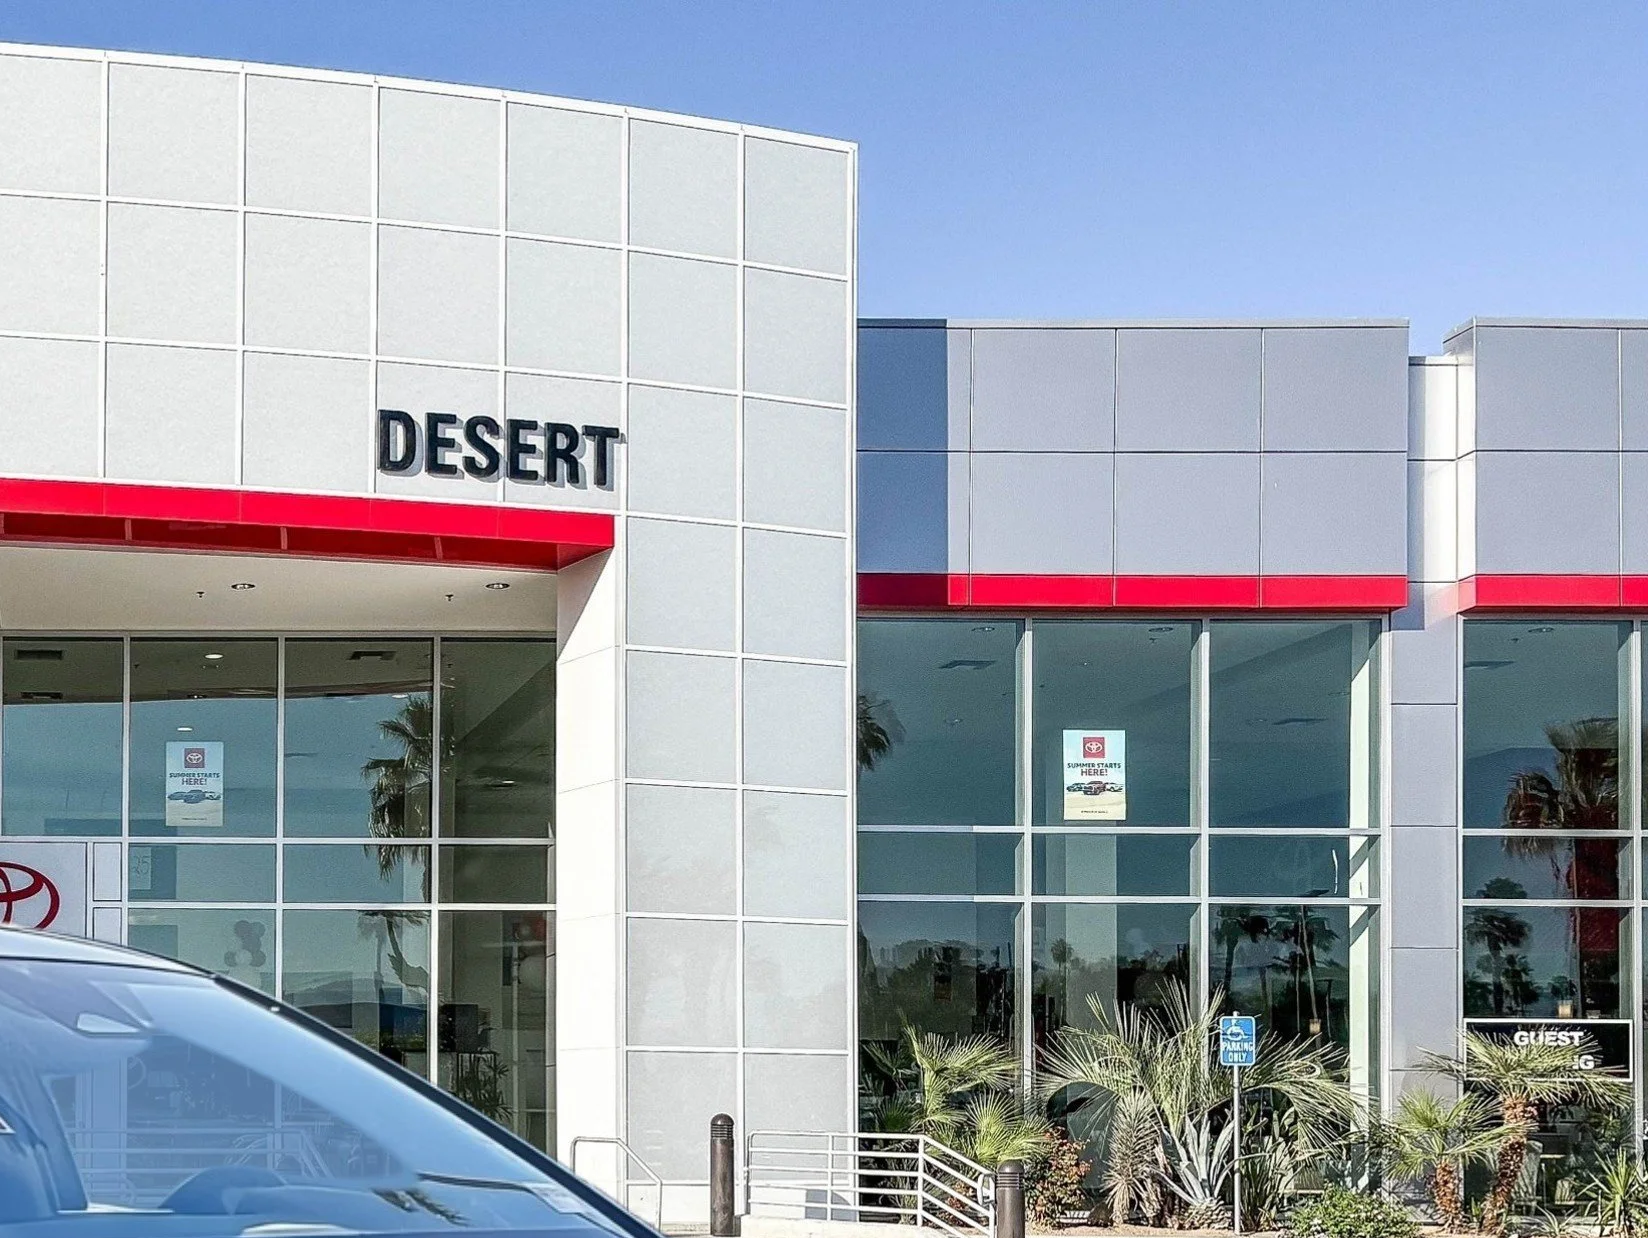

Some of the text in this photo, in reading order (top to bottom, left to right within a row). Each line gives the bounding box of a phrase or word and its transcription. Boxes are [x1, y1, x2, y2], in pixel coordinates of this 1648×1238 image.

[377, 409, 620, 487] DESERT
[1514, 1031, 1584, 1046] GUEST
[1222, 1041, 1253, 1051] PARKING
[1228, 1052, 1247, 1062] ONLY
